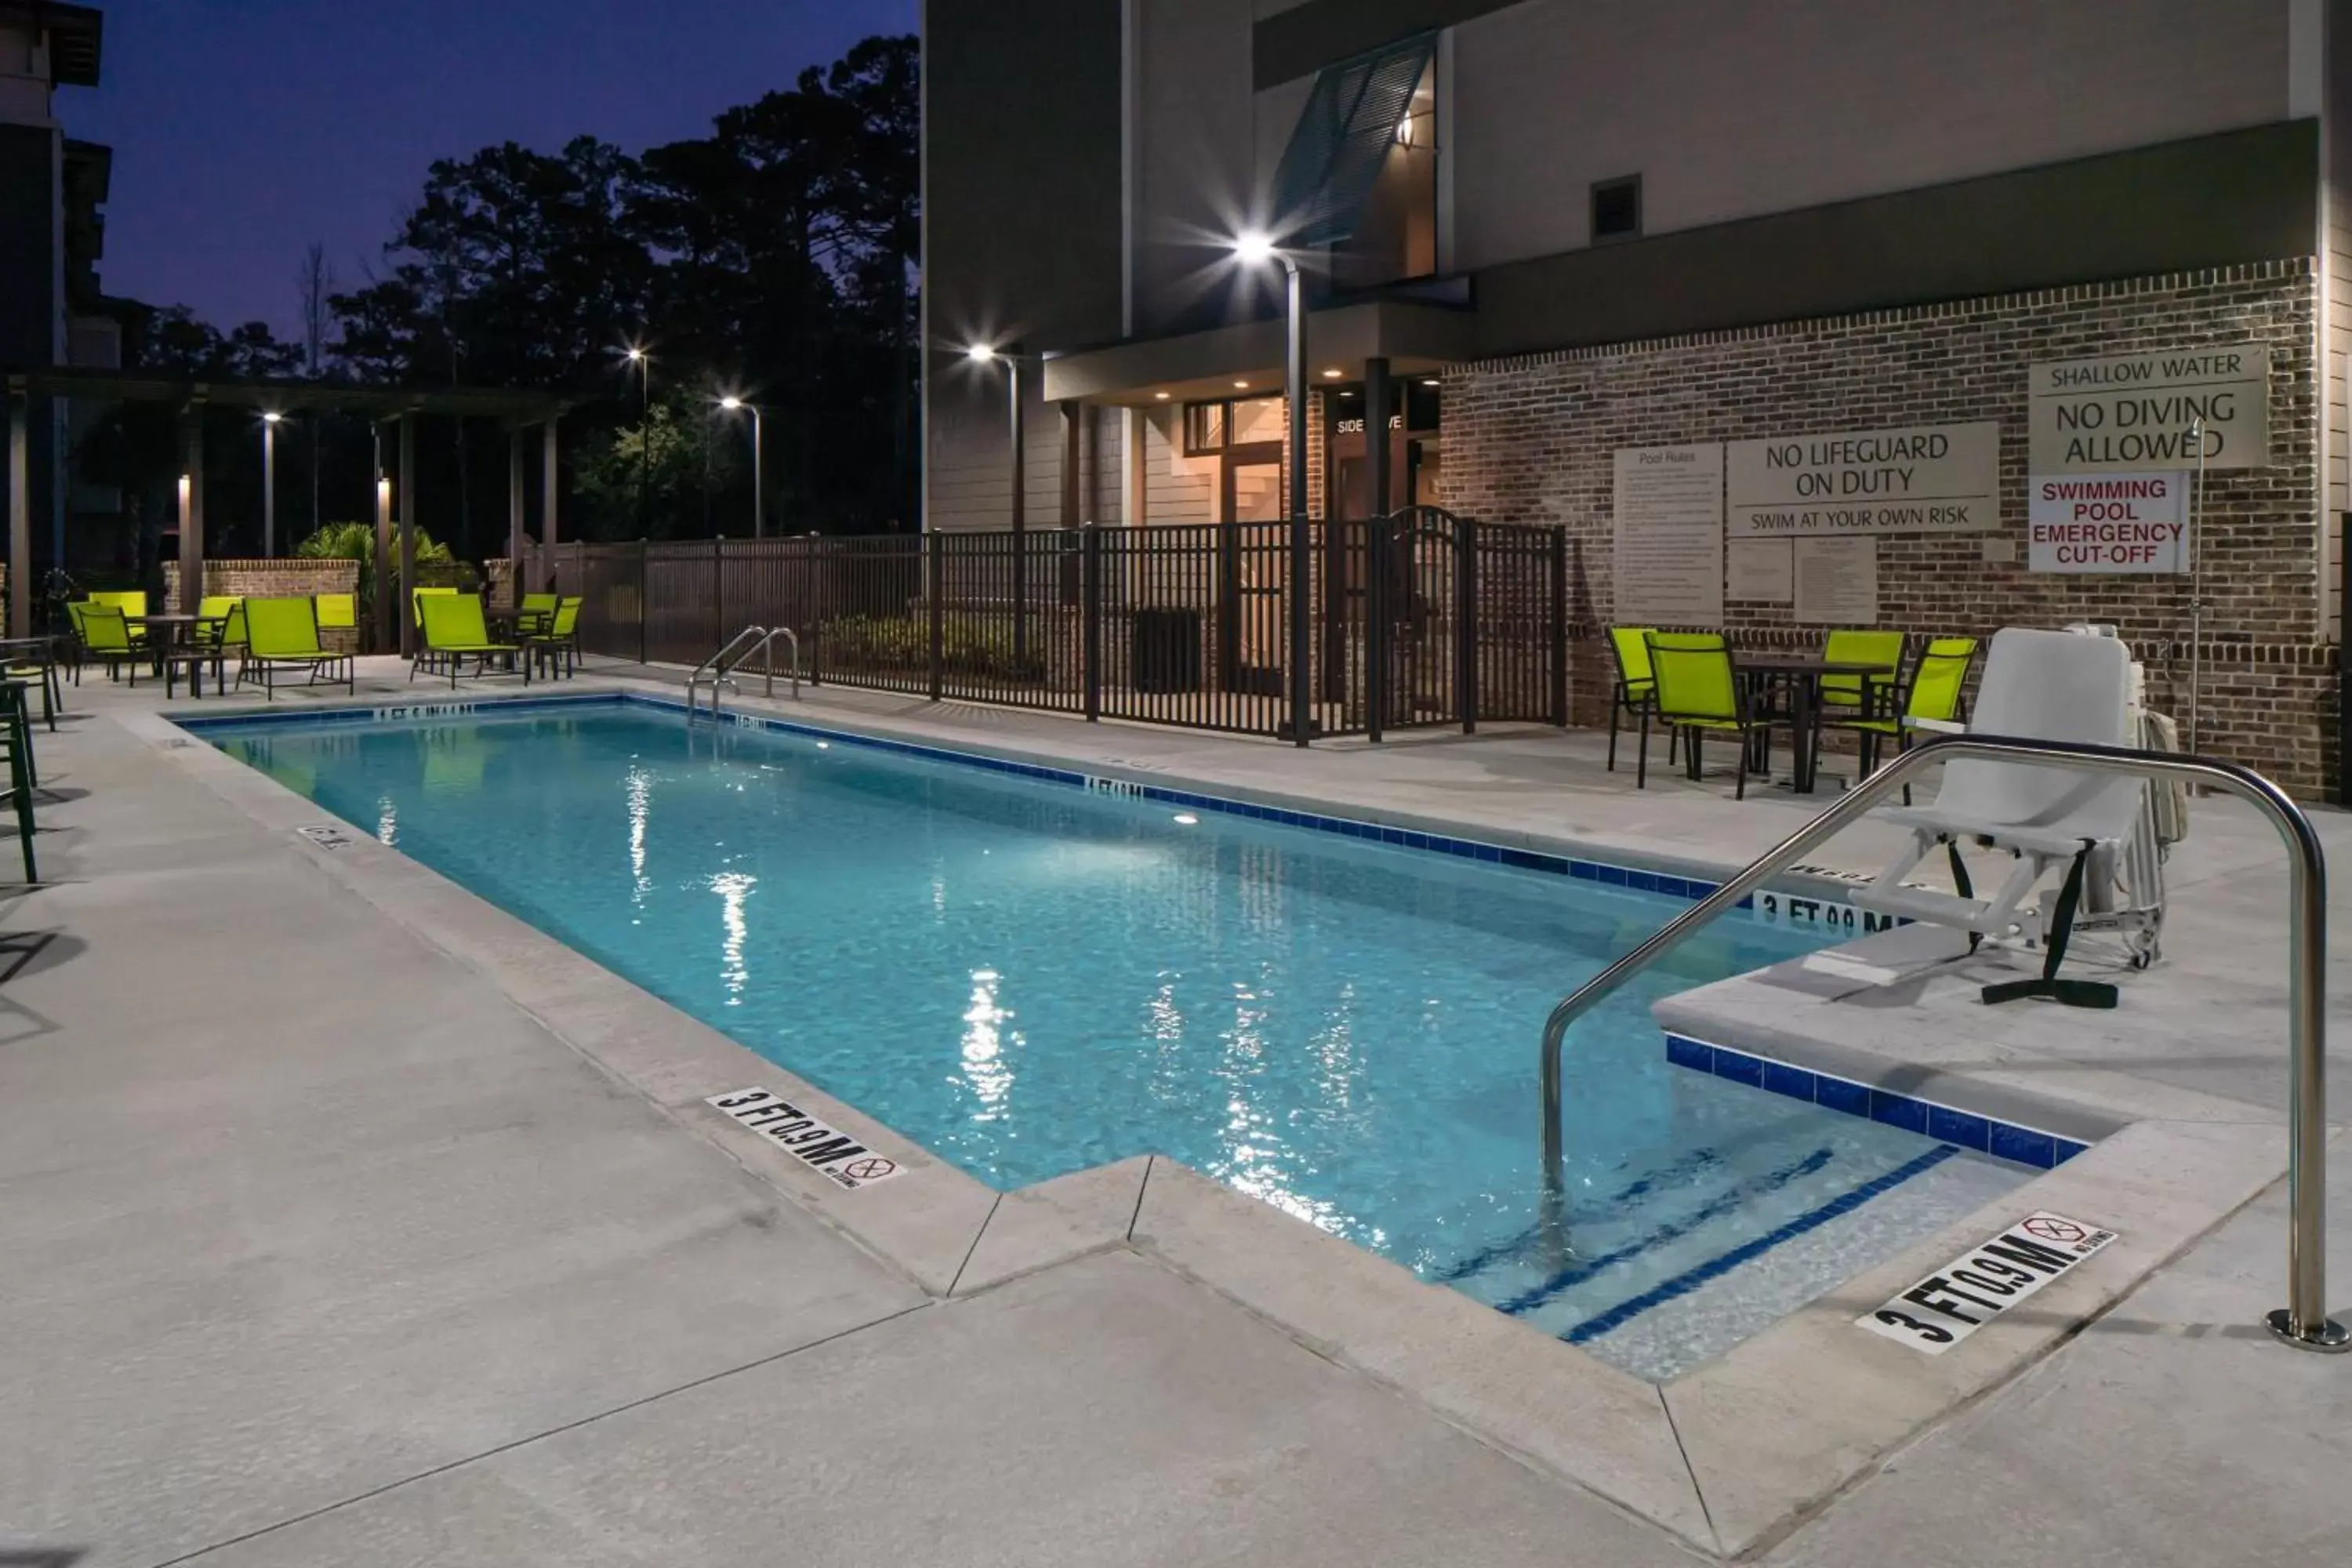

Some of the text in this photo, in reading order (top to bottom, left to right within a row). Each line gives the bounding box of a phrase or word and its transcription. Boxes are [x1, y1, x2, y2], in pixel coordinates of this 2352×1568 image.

[2052, 354, 2241, 387] SHALLOW WATER
[2057, 393, 2234, 431] NO DIVING
[1338, 419, 1364, 434] SIDE
[1639, 452, 1663, 464] Pool
[1766, 434, 1949, 469] NO LIFEGUARD
[2065, 430, 2223, 464] ALLOWED
[1796, 467, 1914, 495] ON DUTY
[2042, 480, 2166, 501] SWIMMING
[1751, 506, 1969, 530] SWIM AT YOUR OWN RISK
[2074, 503, 2140, 521] POOL
[2034, 523, 2183, 543] EMERGENCY
[2056, 545, 2158, 564] CUT-OFF
